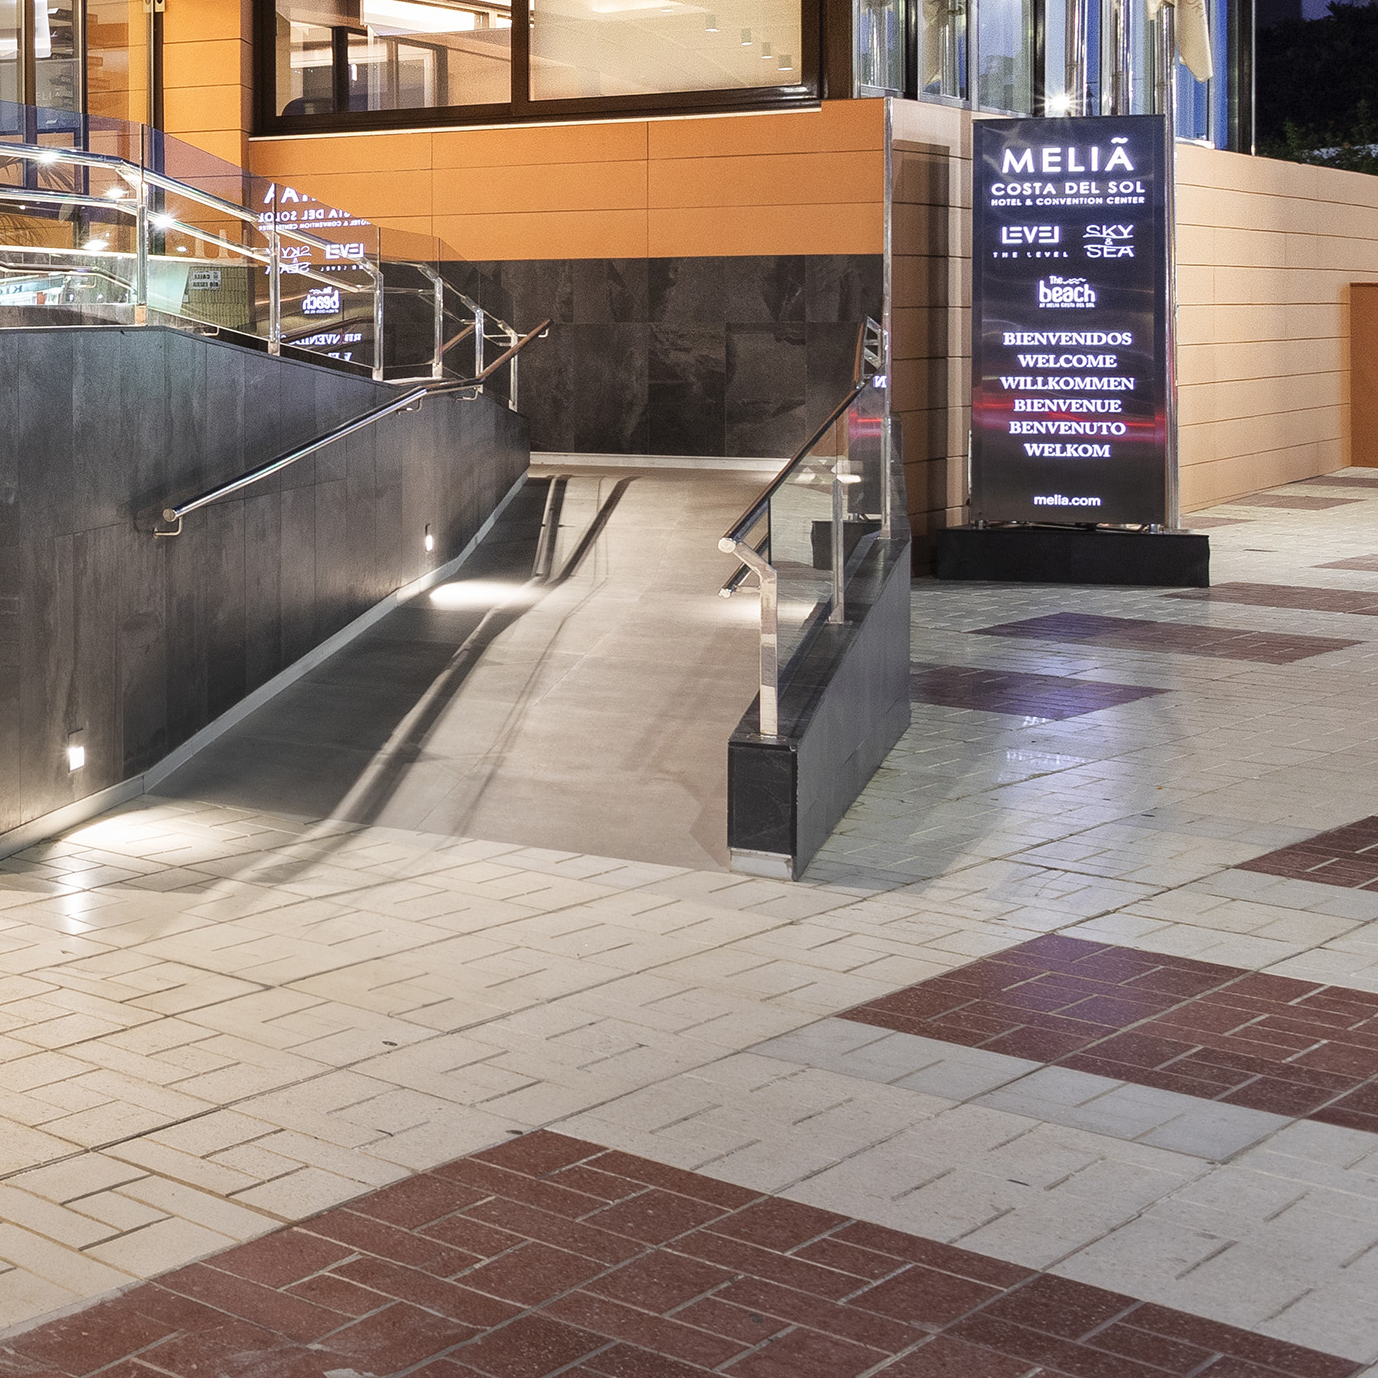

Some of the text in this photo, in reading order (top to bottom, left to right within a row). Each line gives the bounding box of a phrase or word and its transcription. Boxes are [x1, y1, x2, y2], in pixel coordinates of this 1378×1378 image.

[991, 181, 1146, 196] COSTA DEL SOL
[990, 196, 1146, 206] HOTEL & CONVENTION CENTER
[1084, 224, 1134, 238] SKY
[1104, 238, 1114, 246] &
[993, 251, 1069, 259] THE LEVEL
[1084, 245, 1135, 258] SEA
[1039, 279, 1096, 302] beach
[1002, 332, 1132, 345] BIENVENIDOS
[1017, 354, 1118, 368] WELCOME
[999, 376, 1135, 390] WILLKOMMEN
[1013, 399, 1122, 413] BIENVENUE
[1008, 421, 1127, 435] BENVENUTO
[1023, 443, 1111, 457] WELKOM
[1033, 494, 1102, 506] melia.com
